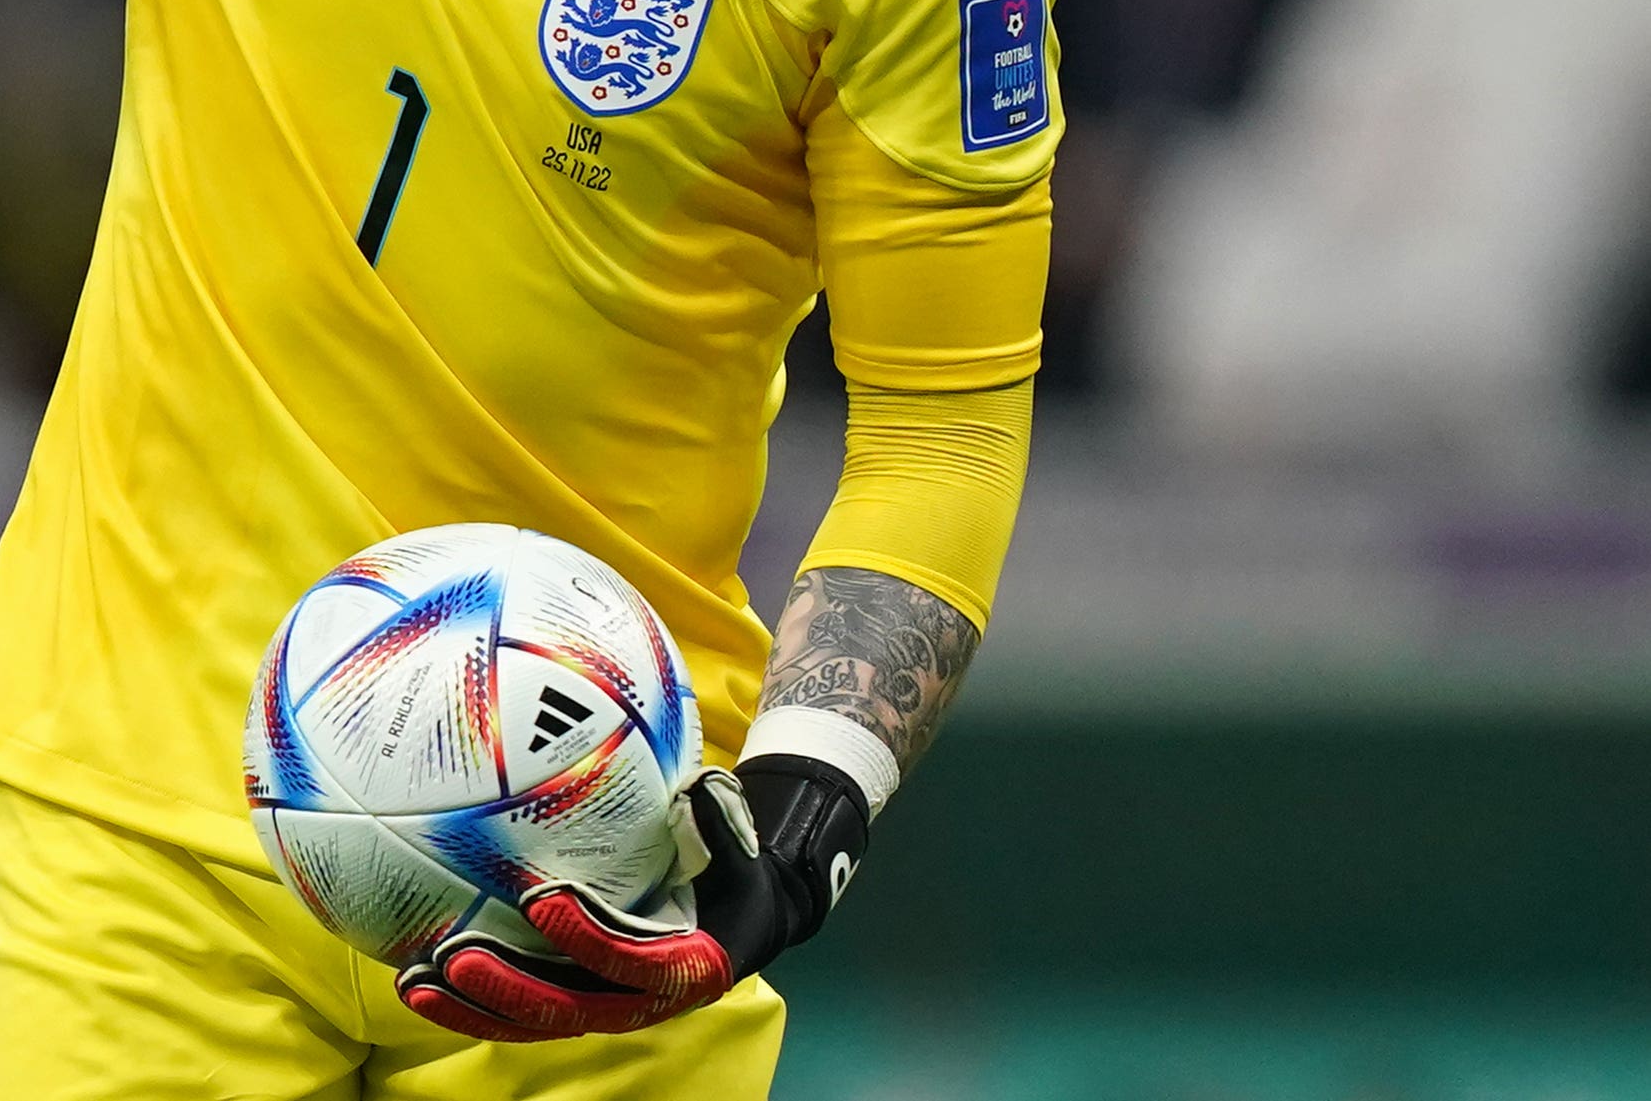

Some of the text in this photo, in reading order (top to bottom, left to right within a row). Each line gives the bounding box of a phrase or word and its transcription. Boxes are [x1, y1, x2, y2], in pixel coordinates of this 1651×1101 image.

[994, 42, 1033, 68] FOOTBALL
[995, 59, 1035, 90] UNITES
[992, 91, 1012, 111] the
[566, 122, 602, 155] USA
[355, 65, 431, 270] 1
[541, 146, 612, 191] 25.11.22
[381, 695, 414, 759] AL RIHLA
